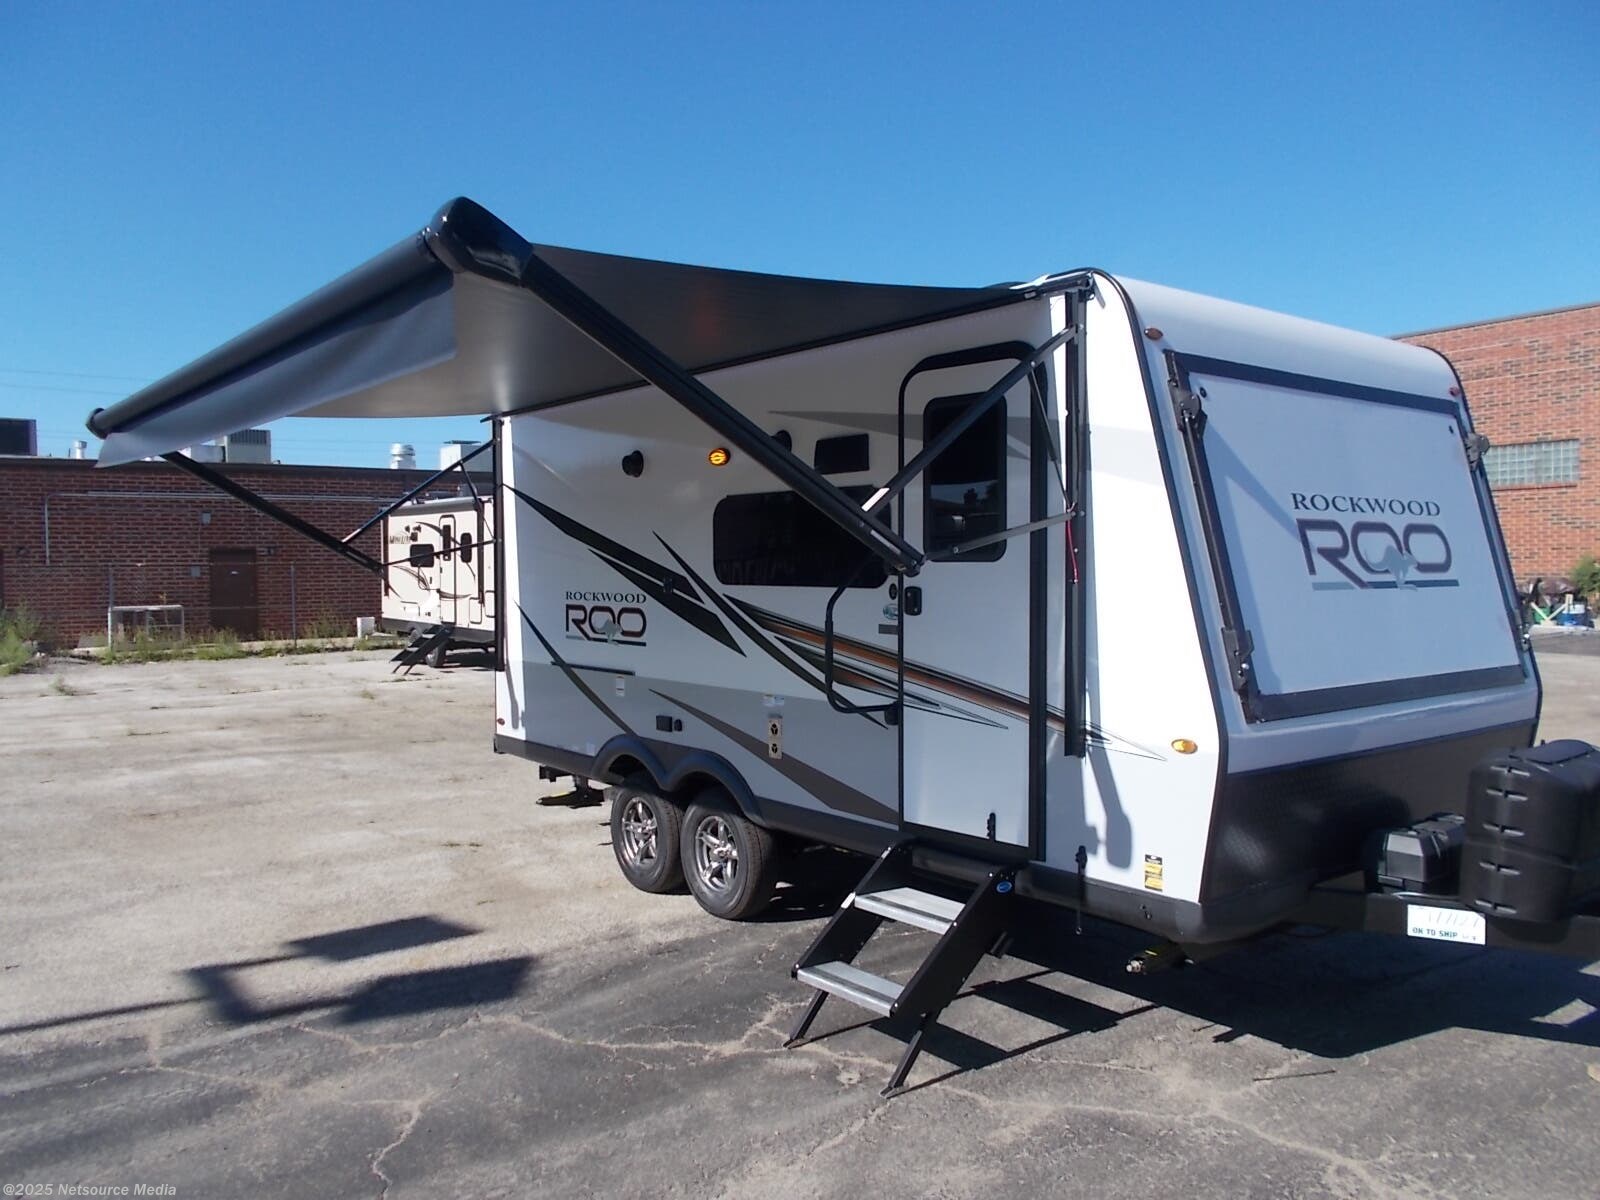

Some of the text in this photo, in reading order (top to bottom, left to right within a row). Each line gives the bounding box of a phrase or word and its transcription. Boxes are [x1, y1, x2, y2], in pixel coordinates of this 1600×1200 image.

[1291, 492, 1441, 517] ROCKWOOD
[1296, 518, 1451, 590] ROO
[565, 591, 647, 604] ROCKWOOD
[565, 603, 647, 640] ROO
